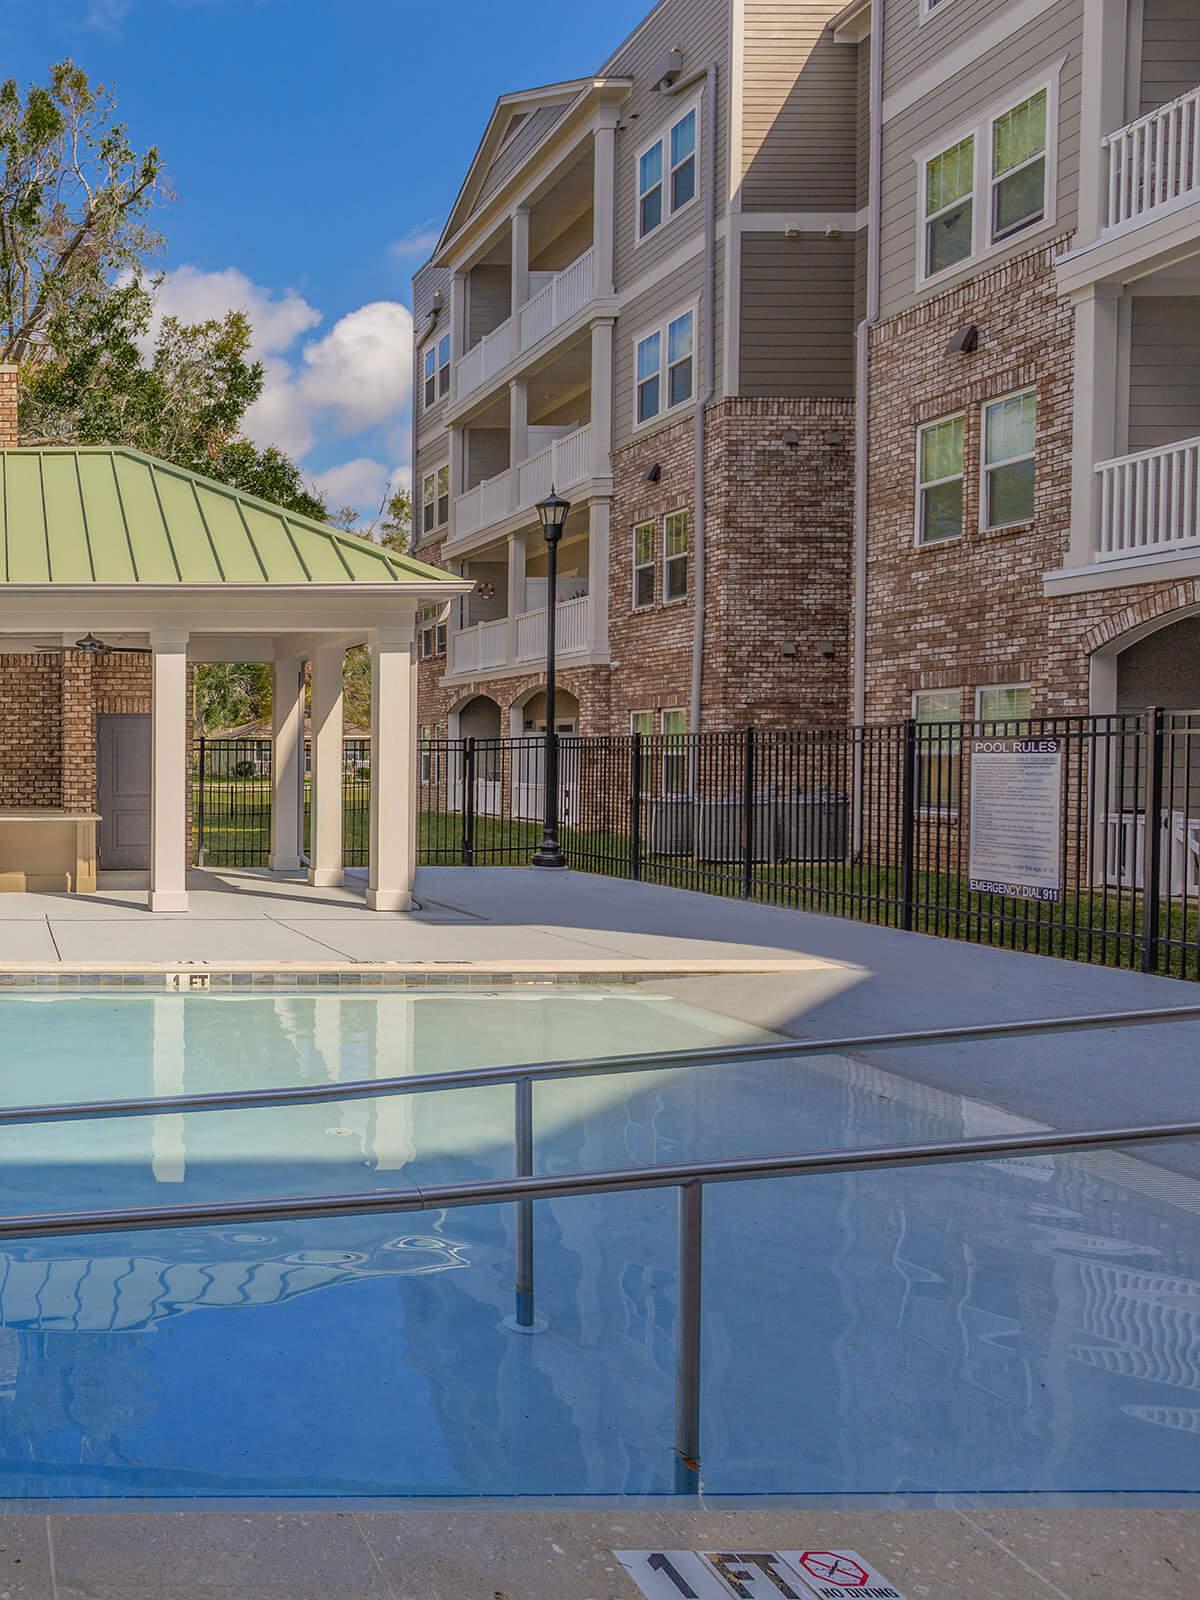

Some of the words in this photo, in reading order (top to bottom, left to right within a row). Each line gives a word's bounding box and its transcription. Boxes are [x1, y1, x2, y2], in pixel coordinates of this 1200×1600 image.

[975, 742, 1009, 753] POOL
[1012, 741, 1057, 753] RULES
[970, 880, 1021, 895] EMERGENCY
[1022, 886, 1042, 899] DIAL
[1042, 888, 1058, 901] 911
[173, 975, 180, 986] 1
[189, 975, 209, 986] FT
[646, 1553, 699, 1599] 1
[703, 1553, 801, 1600] FT
[819, 1587, 845, 1598] NO
[844, 1587, 901, 1598] DIVING
